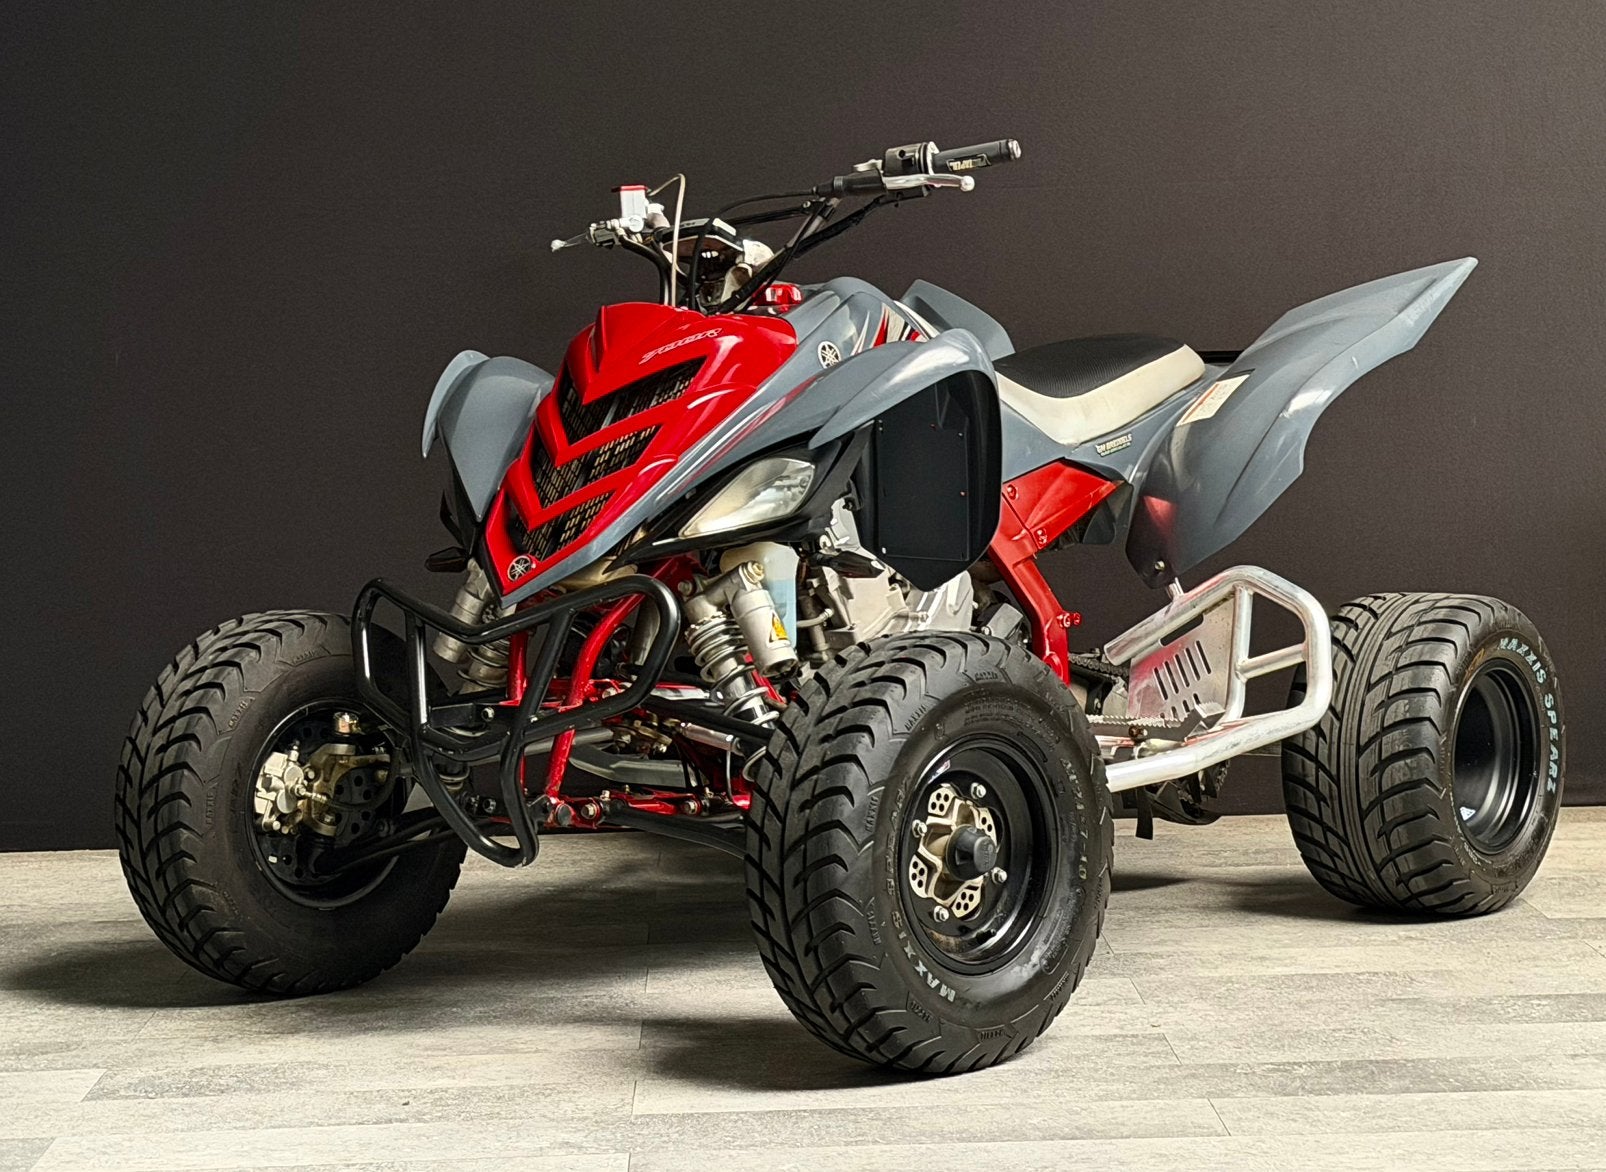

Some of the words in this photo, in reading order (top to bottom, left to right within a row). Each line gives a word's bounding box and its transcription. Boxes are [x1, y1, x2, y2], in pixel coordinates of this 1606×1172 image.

[1498, 637, 1547, 684] MAXXIS
[1544, 693, 1559, 794] SPEARZ
[891, 910, 956, 1003] MAXXIS
